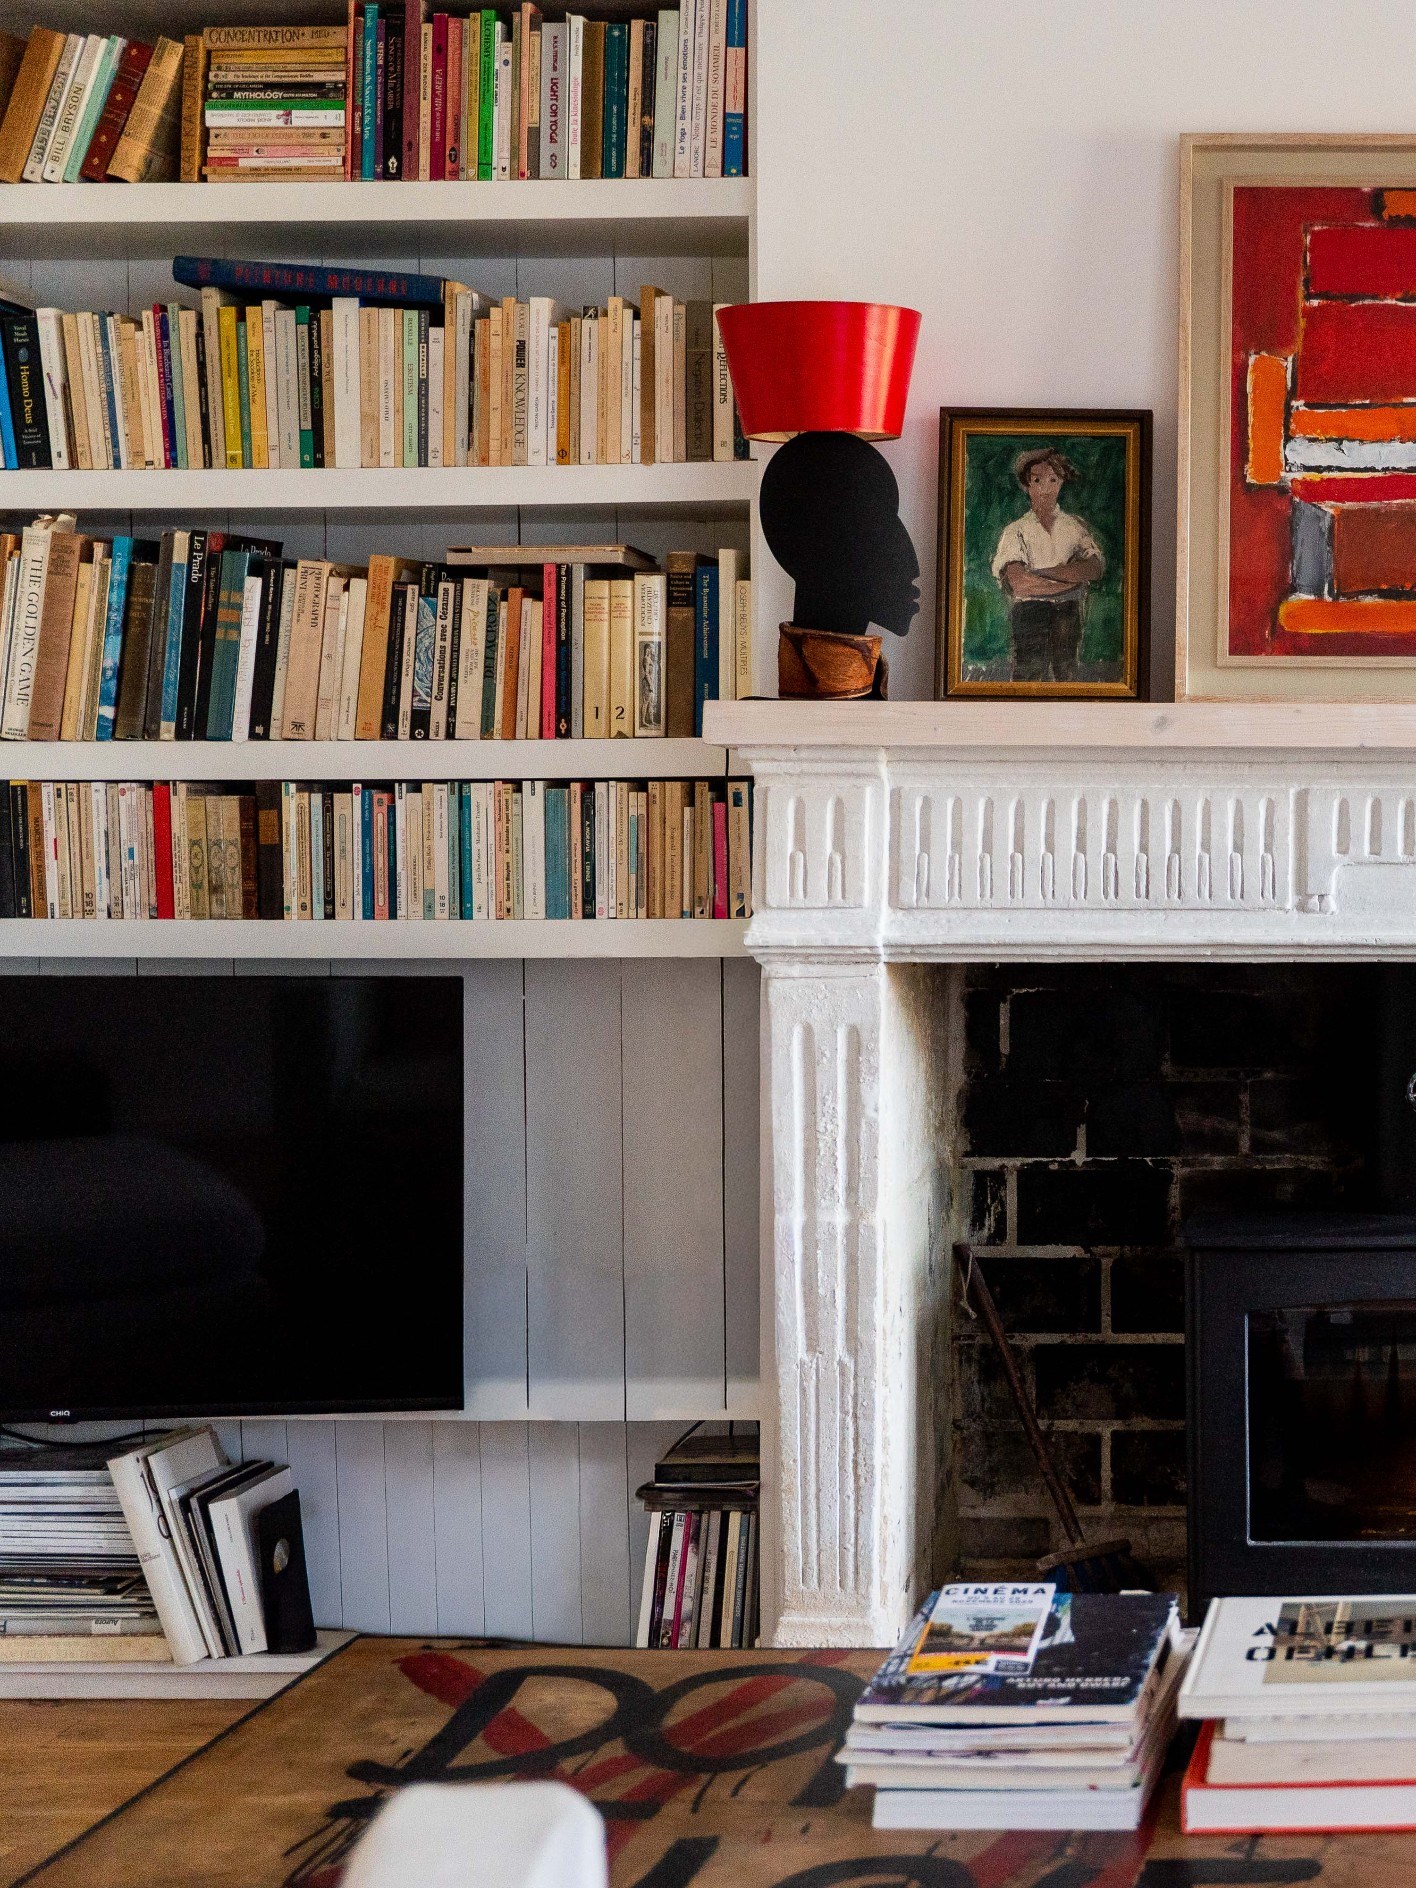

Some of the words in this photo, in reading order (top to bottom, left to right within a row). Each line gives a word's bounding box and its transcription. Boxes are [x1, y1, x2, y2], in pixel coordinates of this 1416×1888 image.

[209, 30, 301, 44] CONCENTRATION
[483, 18, 491, 58] ALCHEMY
[233, 91, 283, 99] MYTHOLOGY
[549, 77, 558, 102] LIGHT
[51, 139, 66, 163] BILL
[61, 85, 83, 133] BRYSON
[353, 111, 361, 134] Suzuki
[549, 104, 558, 117] ON
[549, 119, 558, 144] YOGA
[516, 339, 526, 368] POWER
[20, 365, 30, 397] Homo
[717, 352, 728, 404] REFLECTIONS
[23, 399, 33, 424] Deus
[514, 373, 526, 448] KNOWLEDGE
[193, 536, 205, 549] Le
[29, 556, 43, 588] THE
[191, 552, 204, 583] Prado
[299, 566, 308, 592] PRINT
[310, 568, 322, 628] PHOTOGRAPHY
[559, 576, 567, 600] Primacy
[740, 585, 748, 611] JOSEPH
[439, 587, 449, 621] Cézanne
[701, 588, 709, 618] Byzantine
[22, 592, 40, 657] GOLDEN
[559, 608, 567, 641] Perception
[740, 613, 748, 635] BEUYS
[484, 598, 498, 680] DELACROIX
[740, 640, 748, 676] MULTIPLES
[16, 662, 32, 707] GAME
[434, 645, 446, 701] Conversations
[593, 706, 599, 720] 1
[615, 706, 625, 720] 2
[944, 1585, 1047, 1595] CINÉMA
